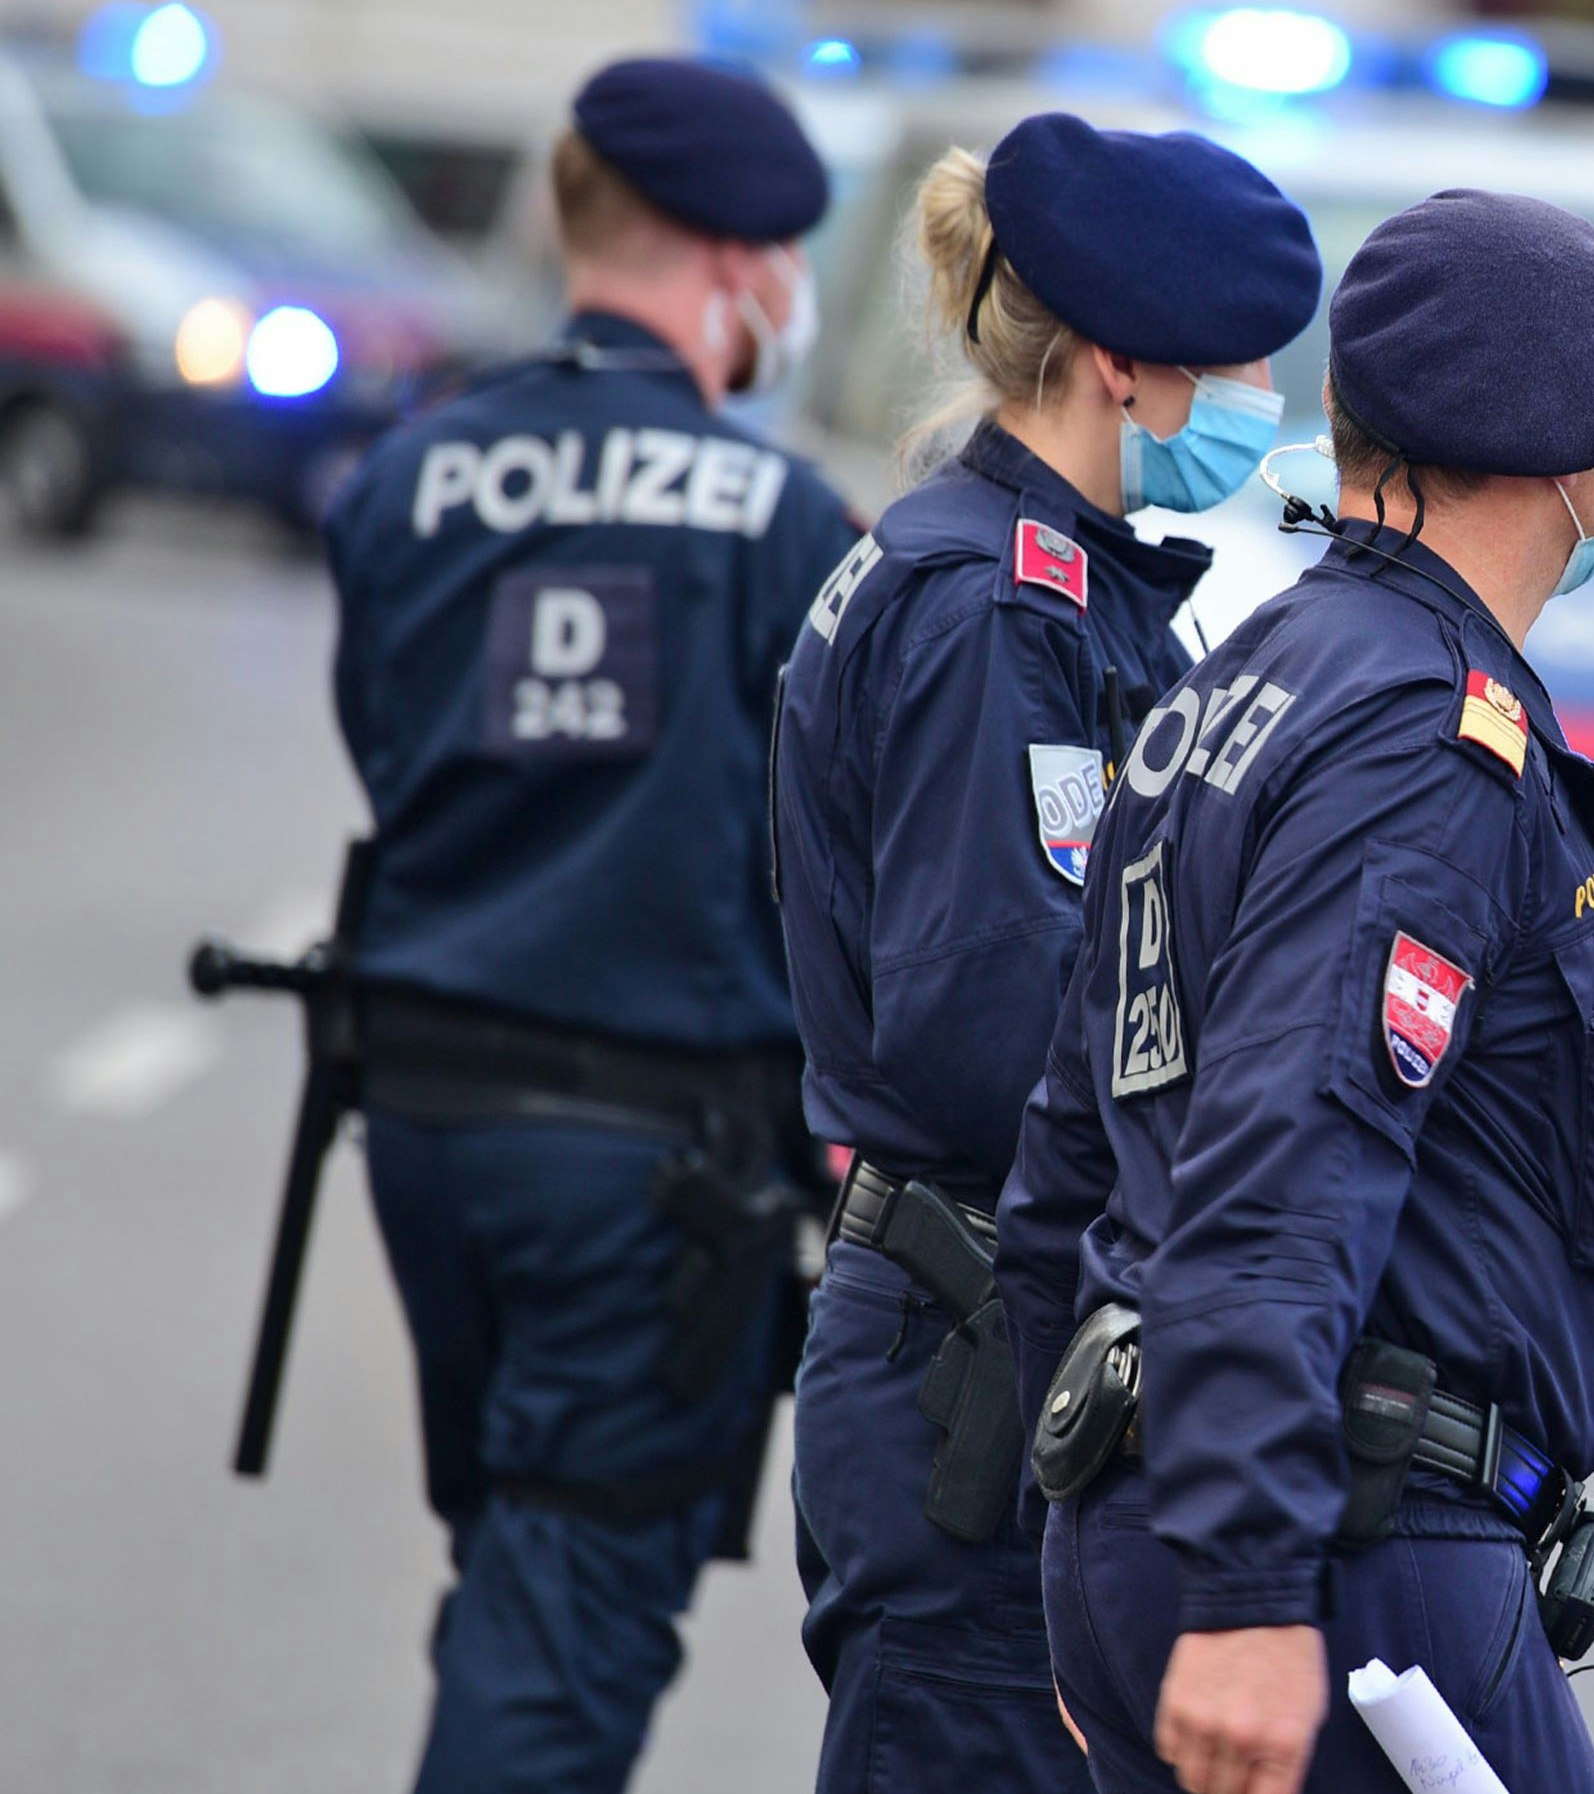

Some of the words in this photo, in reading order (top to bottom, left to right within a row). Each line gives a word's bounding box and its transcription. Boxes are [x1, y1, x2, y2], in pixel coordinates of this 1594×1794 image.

[412, 428, 788, 539] POLIZEI
[530, 588, 606, 677] D
[511, 680, 628, 740] 242
[1139, 878, 1162, 970] D
[1124, 982, 1177, 1077] 250
